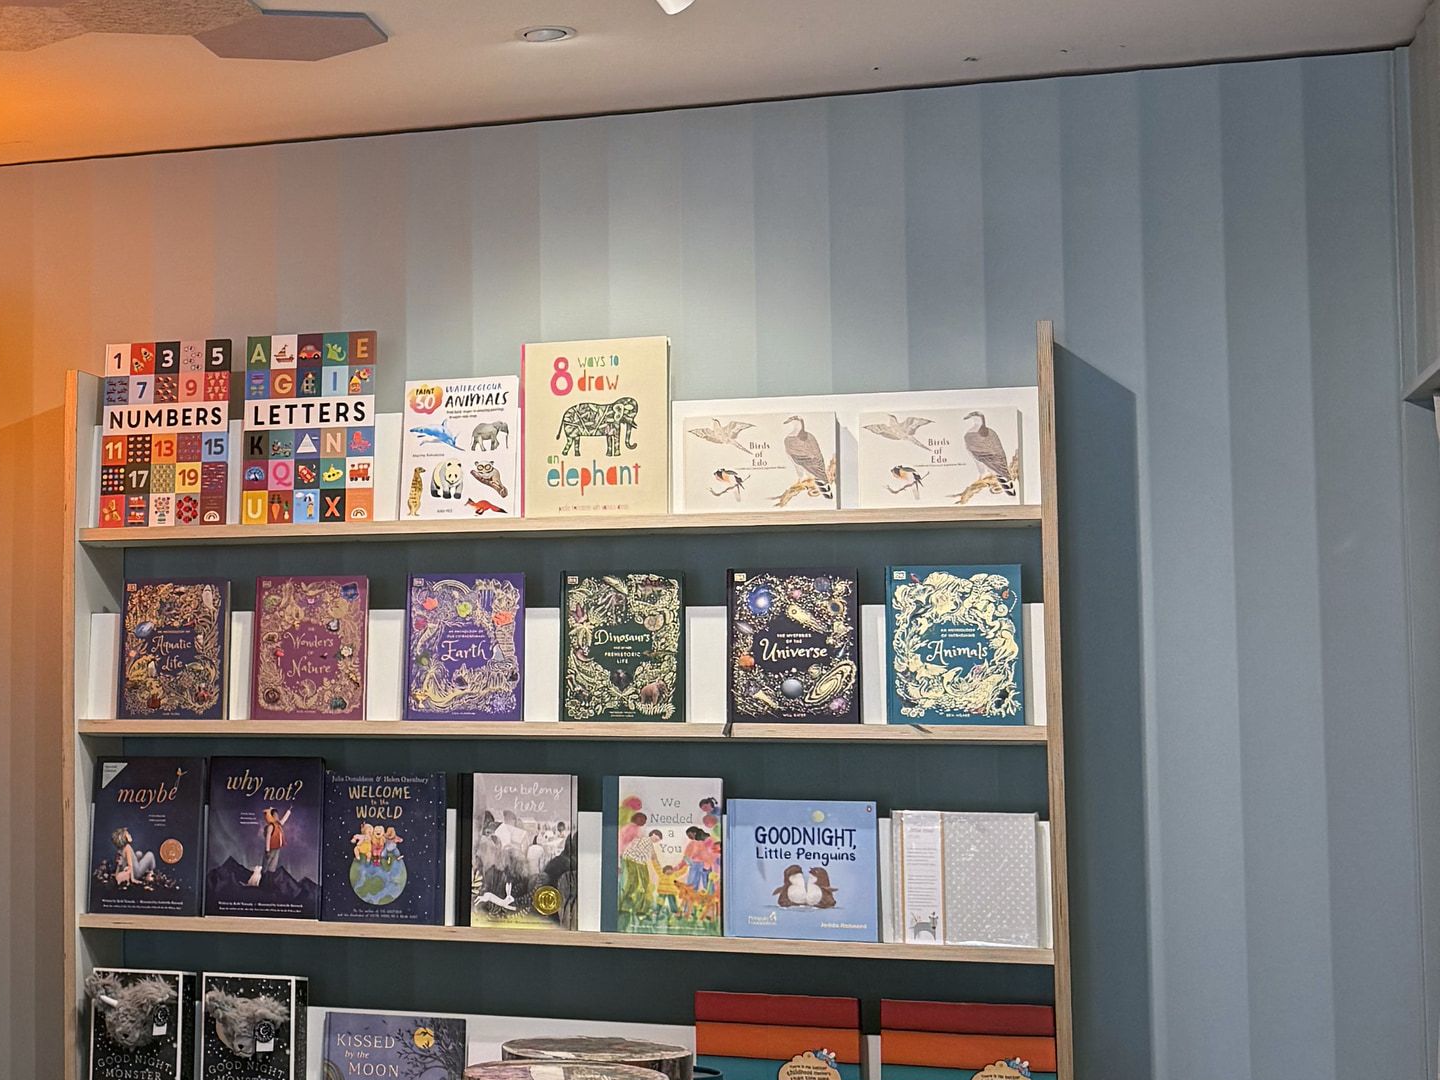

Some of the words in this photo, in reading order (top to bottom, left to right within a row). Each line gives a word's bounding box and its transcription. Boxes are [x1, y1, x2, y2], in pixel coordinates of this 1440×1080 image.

[114, 353, 122, 369] 1
[162, 350, 173, 367] 3
[212, 347, 224, 365] 5
[577, 355, 605, 369] ways
[609, 355, 619, 366] to
[550, 357, 574, 396] 8
[577, 369, 619, 392] draw
[137, 382, 147, 399] 7
[186, 380, 197, 396] 9
[415, 396, 435, 409] 50
[445, 392, 509, 408] ANIMALS
[110, 406, 222, 429] NUMBERS
[254, 401, 366, 425] LETTERS
[105, 442, 122, 460] 11
[154, 440, 174, 457] 13
[205, 438, 224, 455] 15
[749, 441, 770, 450] Birds
[927, 438, 950, 447] Birds
[547, 455, 560, 465] an
[752, 459, 768, 467] Edo
[931, 456, 947, 464] Edo
[128, 470, 149, 488] 17
[178, 469, 198, 485] 19
[547, 460, 640, 496] elephant
[151, 634, 192, 654] Aquatic
[284, 632, 334, 649] Wonders
[594, 629, 650, 645] Dinosaurs
[440, 640, 488, 661] Earth
[759, 638, 828, 662] Universe
[926, 639, 988, 662] Animals
[162, 657, 183, 672] Life
[287, 656, 331, 678] Nature
[226, 769, 263, 797] why
[263, 780, 303, 801] not?
[494, 784, 518, 797] you
[519, 782, 564, 797] belong
[117, 782, 177, 810] maybe
[348, 785, 411, 800] WELCOME
[513, 798, 548, 813] here
[661, 798, 681, 808] We
[356, 805, 403, 820] WORLD
[650, 813, 693, 824] Needed
[754, 826, 857, 850] GOODNIGHT,
[661, 844, 682, 854] You
[755, 847, 792, 860] Little
[796, 846, 856, 866] Penguins
[336, 1033, 395, 1050] KISSED
[97, 1054, 130, 1068] GOOD
[134, 1054, 172, 1071] NIGHT
[344, 1049, 354, 1059] by
[355, 1050, 370, 1059] the
[105, 1069, 162, 1080] MONSTER
[208, 1061, 242, 1074] GOOD
[246, 1061, 285, 1079] NIGHT
[348, 1062, 400, 1078] MOON
